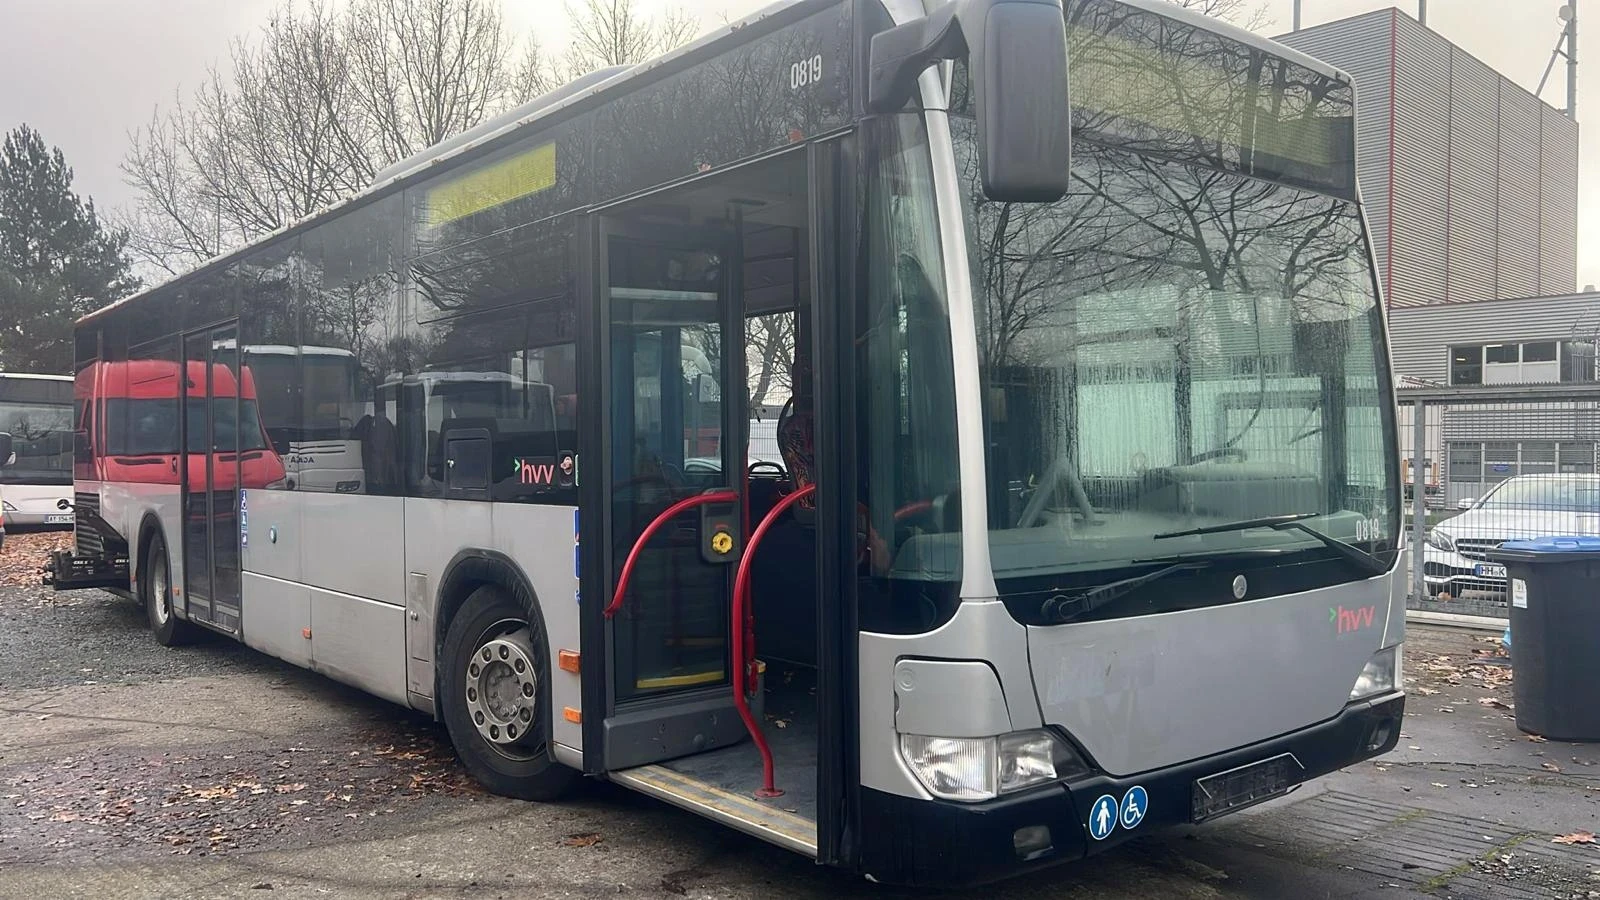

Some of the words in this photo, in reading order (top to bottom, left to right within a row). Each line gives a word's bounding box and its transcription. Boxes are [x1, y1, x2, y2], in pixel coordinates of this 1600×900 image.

[791, 54, 822, 89] 0819
[521, 459, 555, 484] hvv
[1356, 518, 1379, 541] 0819
